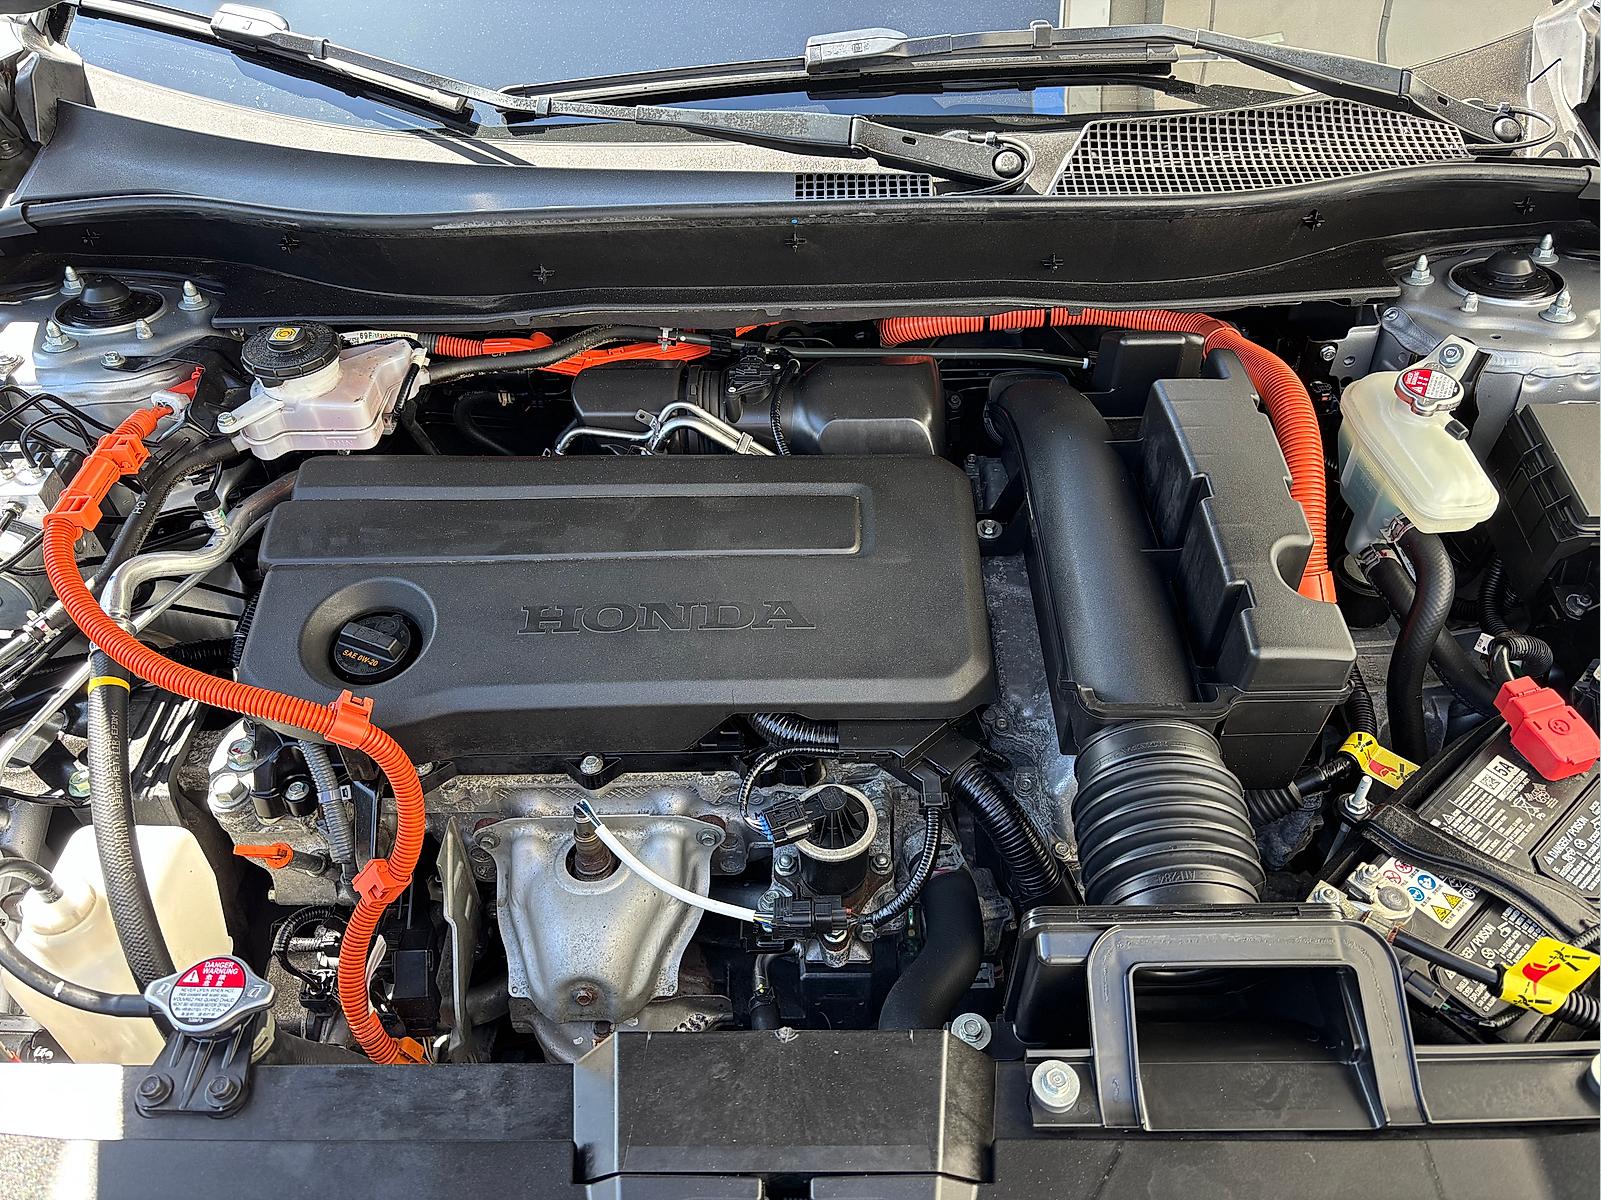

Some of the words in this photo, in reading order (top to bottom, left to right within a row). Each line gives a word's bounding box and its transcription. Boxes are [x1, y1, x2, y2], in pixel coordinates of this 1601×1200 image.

[517, 601, 816, 635] HONDA
[342, 650, 358, 659] SAE
[357, 656, 379, 667] 0W-20
[1493, 759, 1513, 777] 5A
